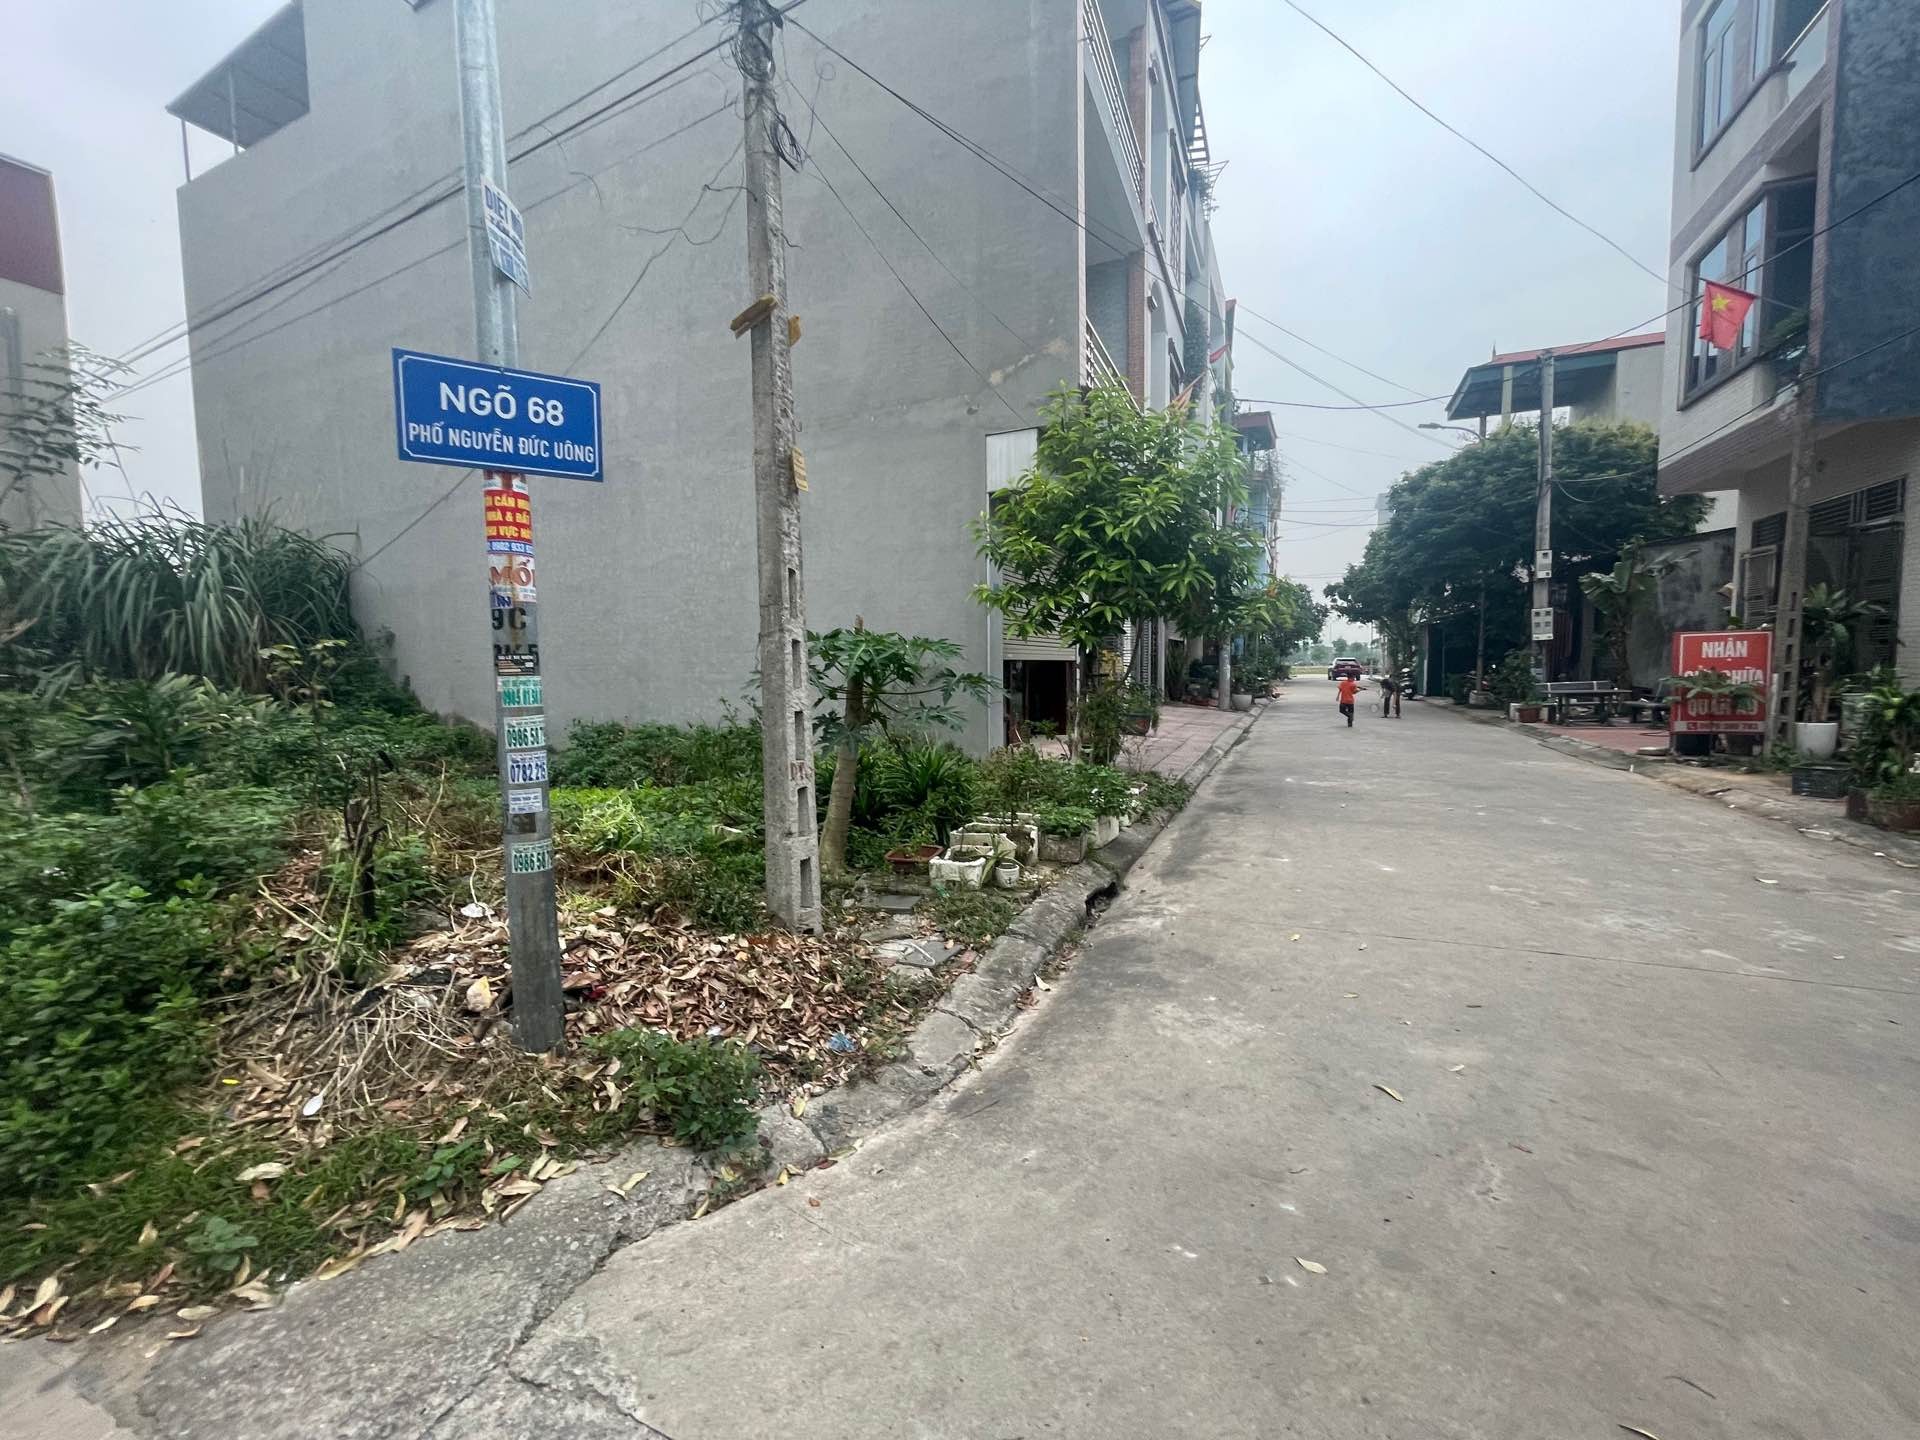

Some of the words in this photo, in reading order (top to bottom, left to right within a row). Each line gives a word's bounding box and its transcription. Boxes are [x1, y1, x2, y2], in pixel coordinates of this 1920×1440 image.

[439, 382, 516, 420] NGÕ
[527, 397, 564, 427] 68
[409, 421, 444, 445] PHỐ
[449, 428, 513, 454] NGUYỄN
[518, 434, 549, 458] ĐỨC
[554, 440, 594, 463] UÔNG
[1701, 637, 1748, 661] NHẬN
